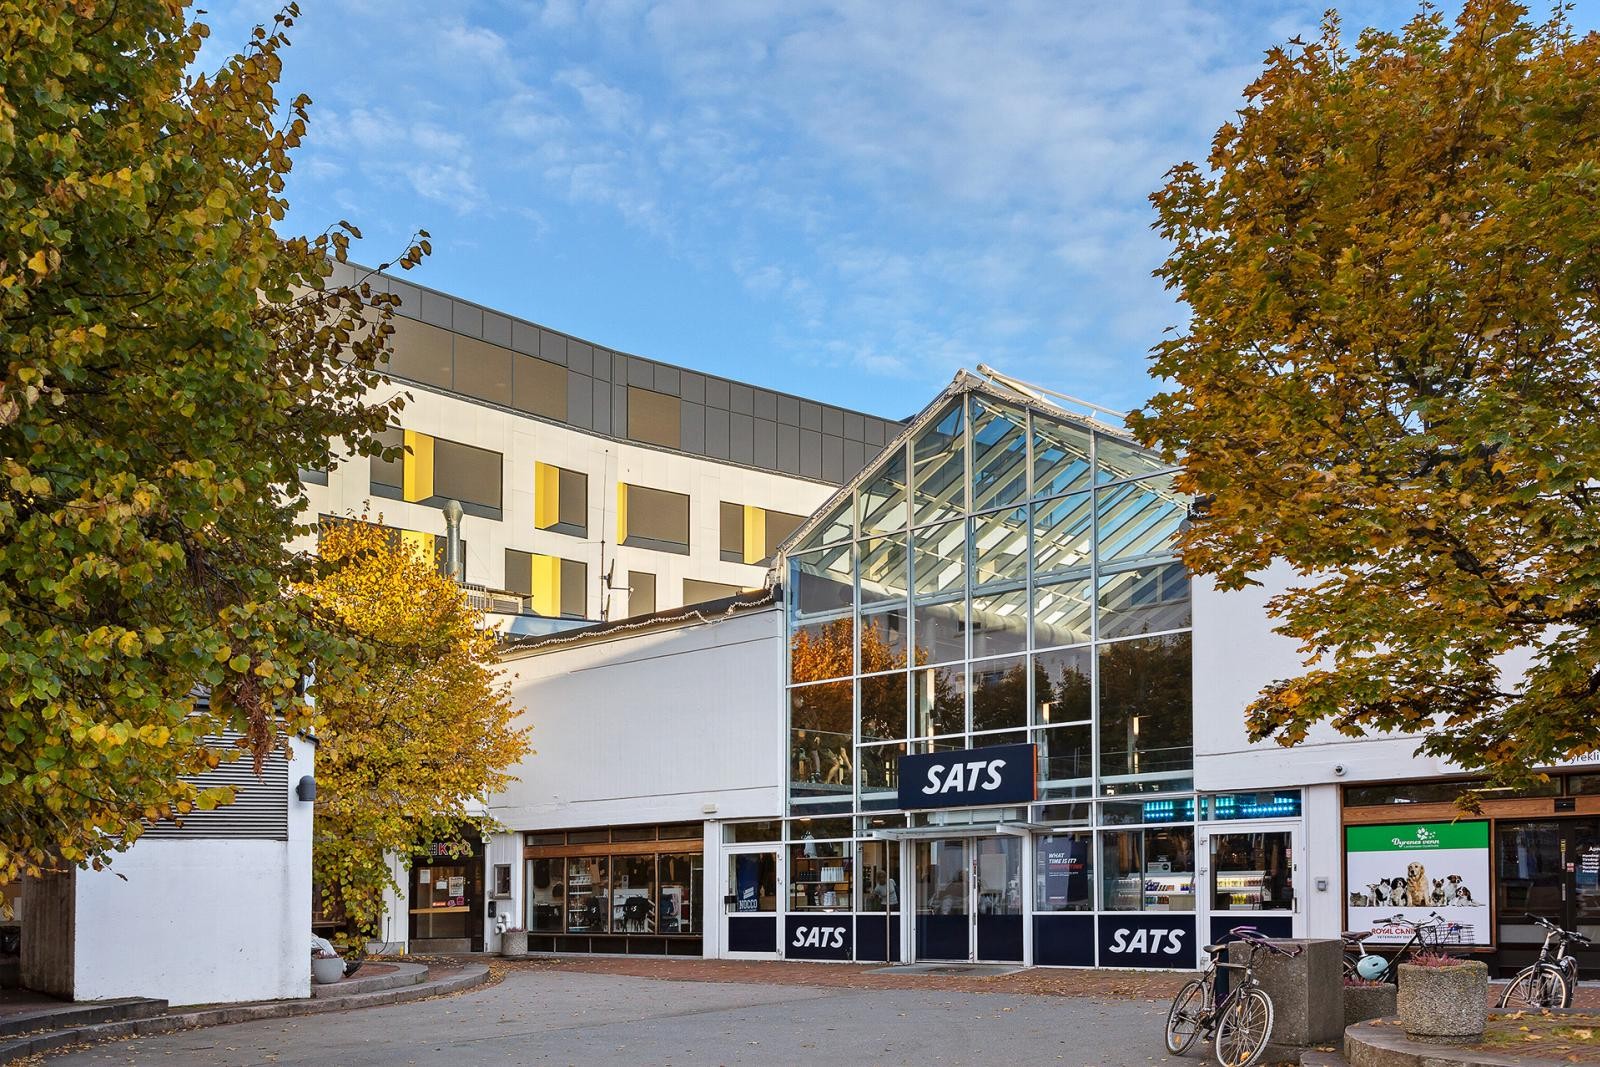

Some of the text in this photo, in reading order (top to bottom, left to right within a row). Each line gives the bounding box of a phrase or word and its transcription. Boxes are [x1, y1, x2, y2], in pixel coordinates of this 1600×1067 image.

[921, 759, 1007, 795] SATS
[1391, 838, 1421, 848] Dyrenes
[739, 899, 758, 910] NOCCO
[792, 926, 847, 948] SATS
[1108, 928, 1187, 954] SATS
